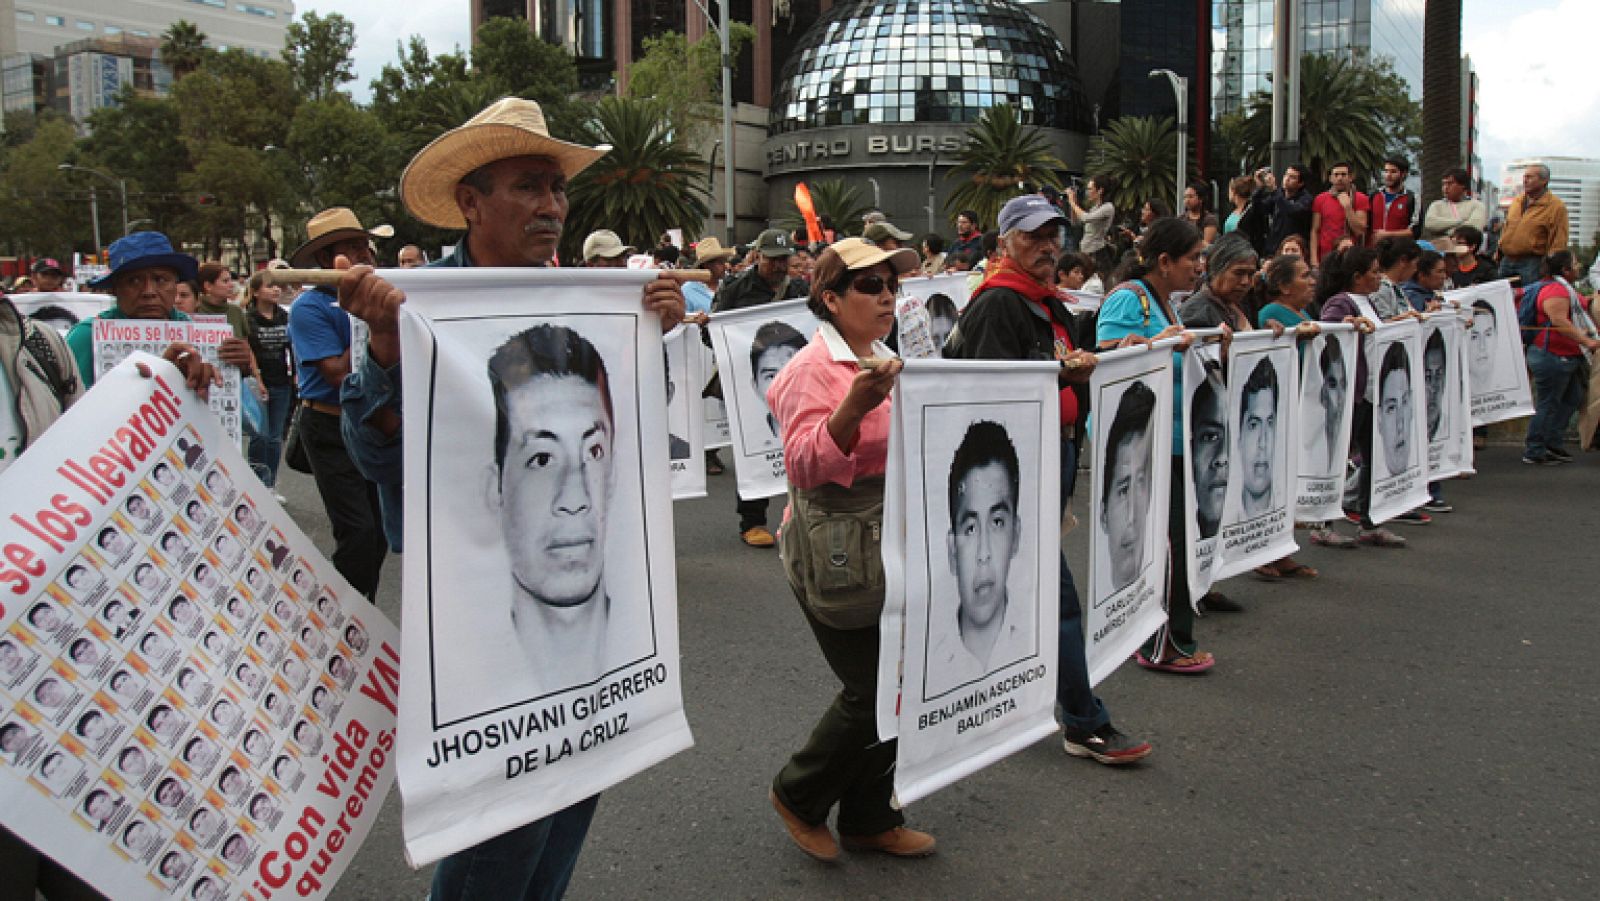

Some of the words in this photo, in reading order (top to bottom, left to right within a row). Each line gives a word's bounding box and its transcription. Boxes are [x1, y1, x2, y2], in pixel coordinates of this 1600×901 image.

[145, 325, 162, 342] se
[164, 323, 184, 342] los
[9, 493, 93, 554] los
[56, 374, 182, 506] llevaron!
[426, 702, 566, 769] JHOSIVANI
[572, 662, 668, 721] GUERRERO
[918, 688, 988, 731] BENJAMÍN
[988, 664, 1047, 698] ASCENCIO
[956, 697, 1018, 735] BAUTISTA
[505, 747, 539, 781] DE
[544, 737, 574, 765] LA
[578, 711, 630, 752] CRUZ
[252, 804, 326, 899] ¡Con
[316, 718, 370, 800] vida
